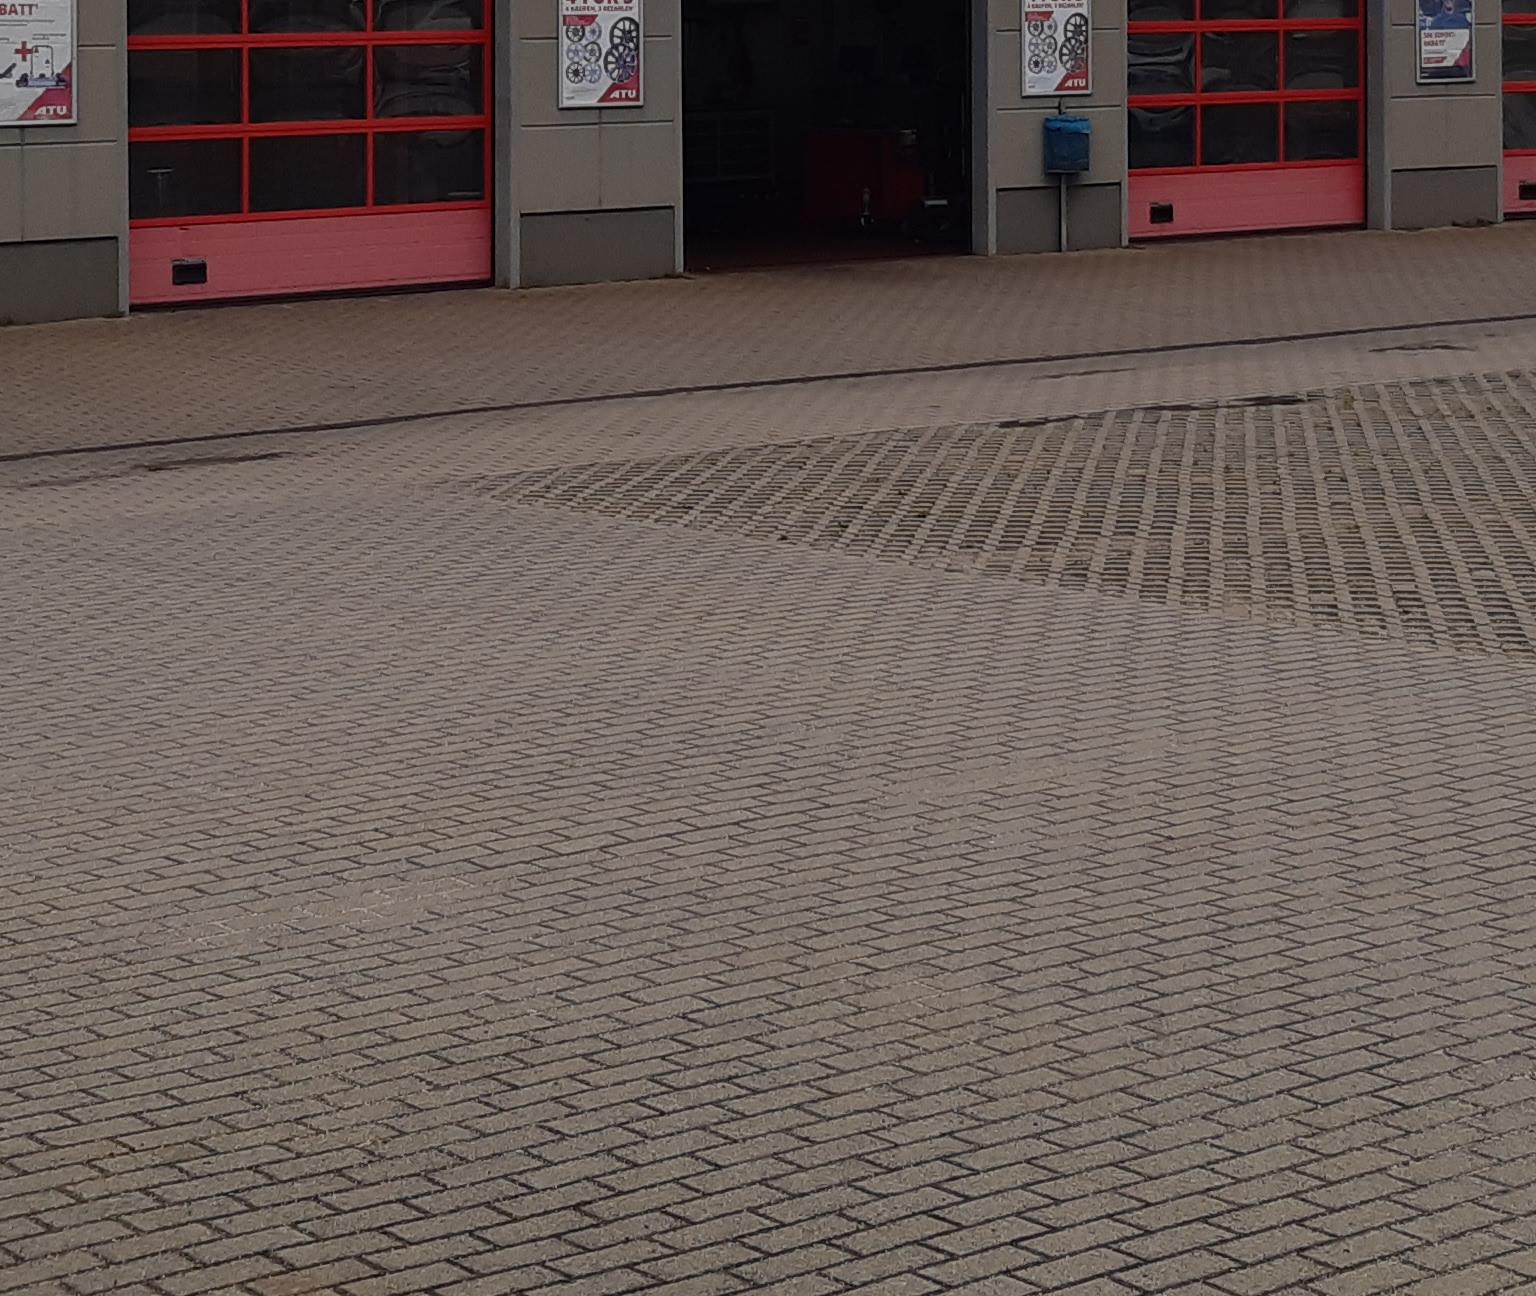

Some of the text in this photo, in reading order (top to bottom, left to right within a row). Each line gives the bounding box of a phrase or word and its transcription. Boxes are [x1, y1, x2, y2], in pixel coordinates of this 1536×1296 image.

[1064, 79, 1086, 88] ATU
[609, 89, 637, 99] ATU
[34, 106, 68, 115] ATU
